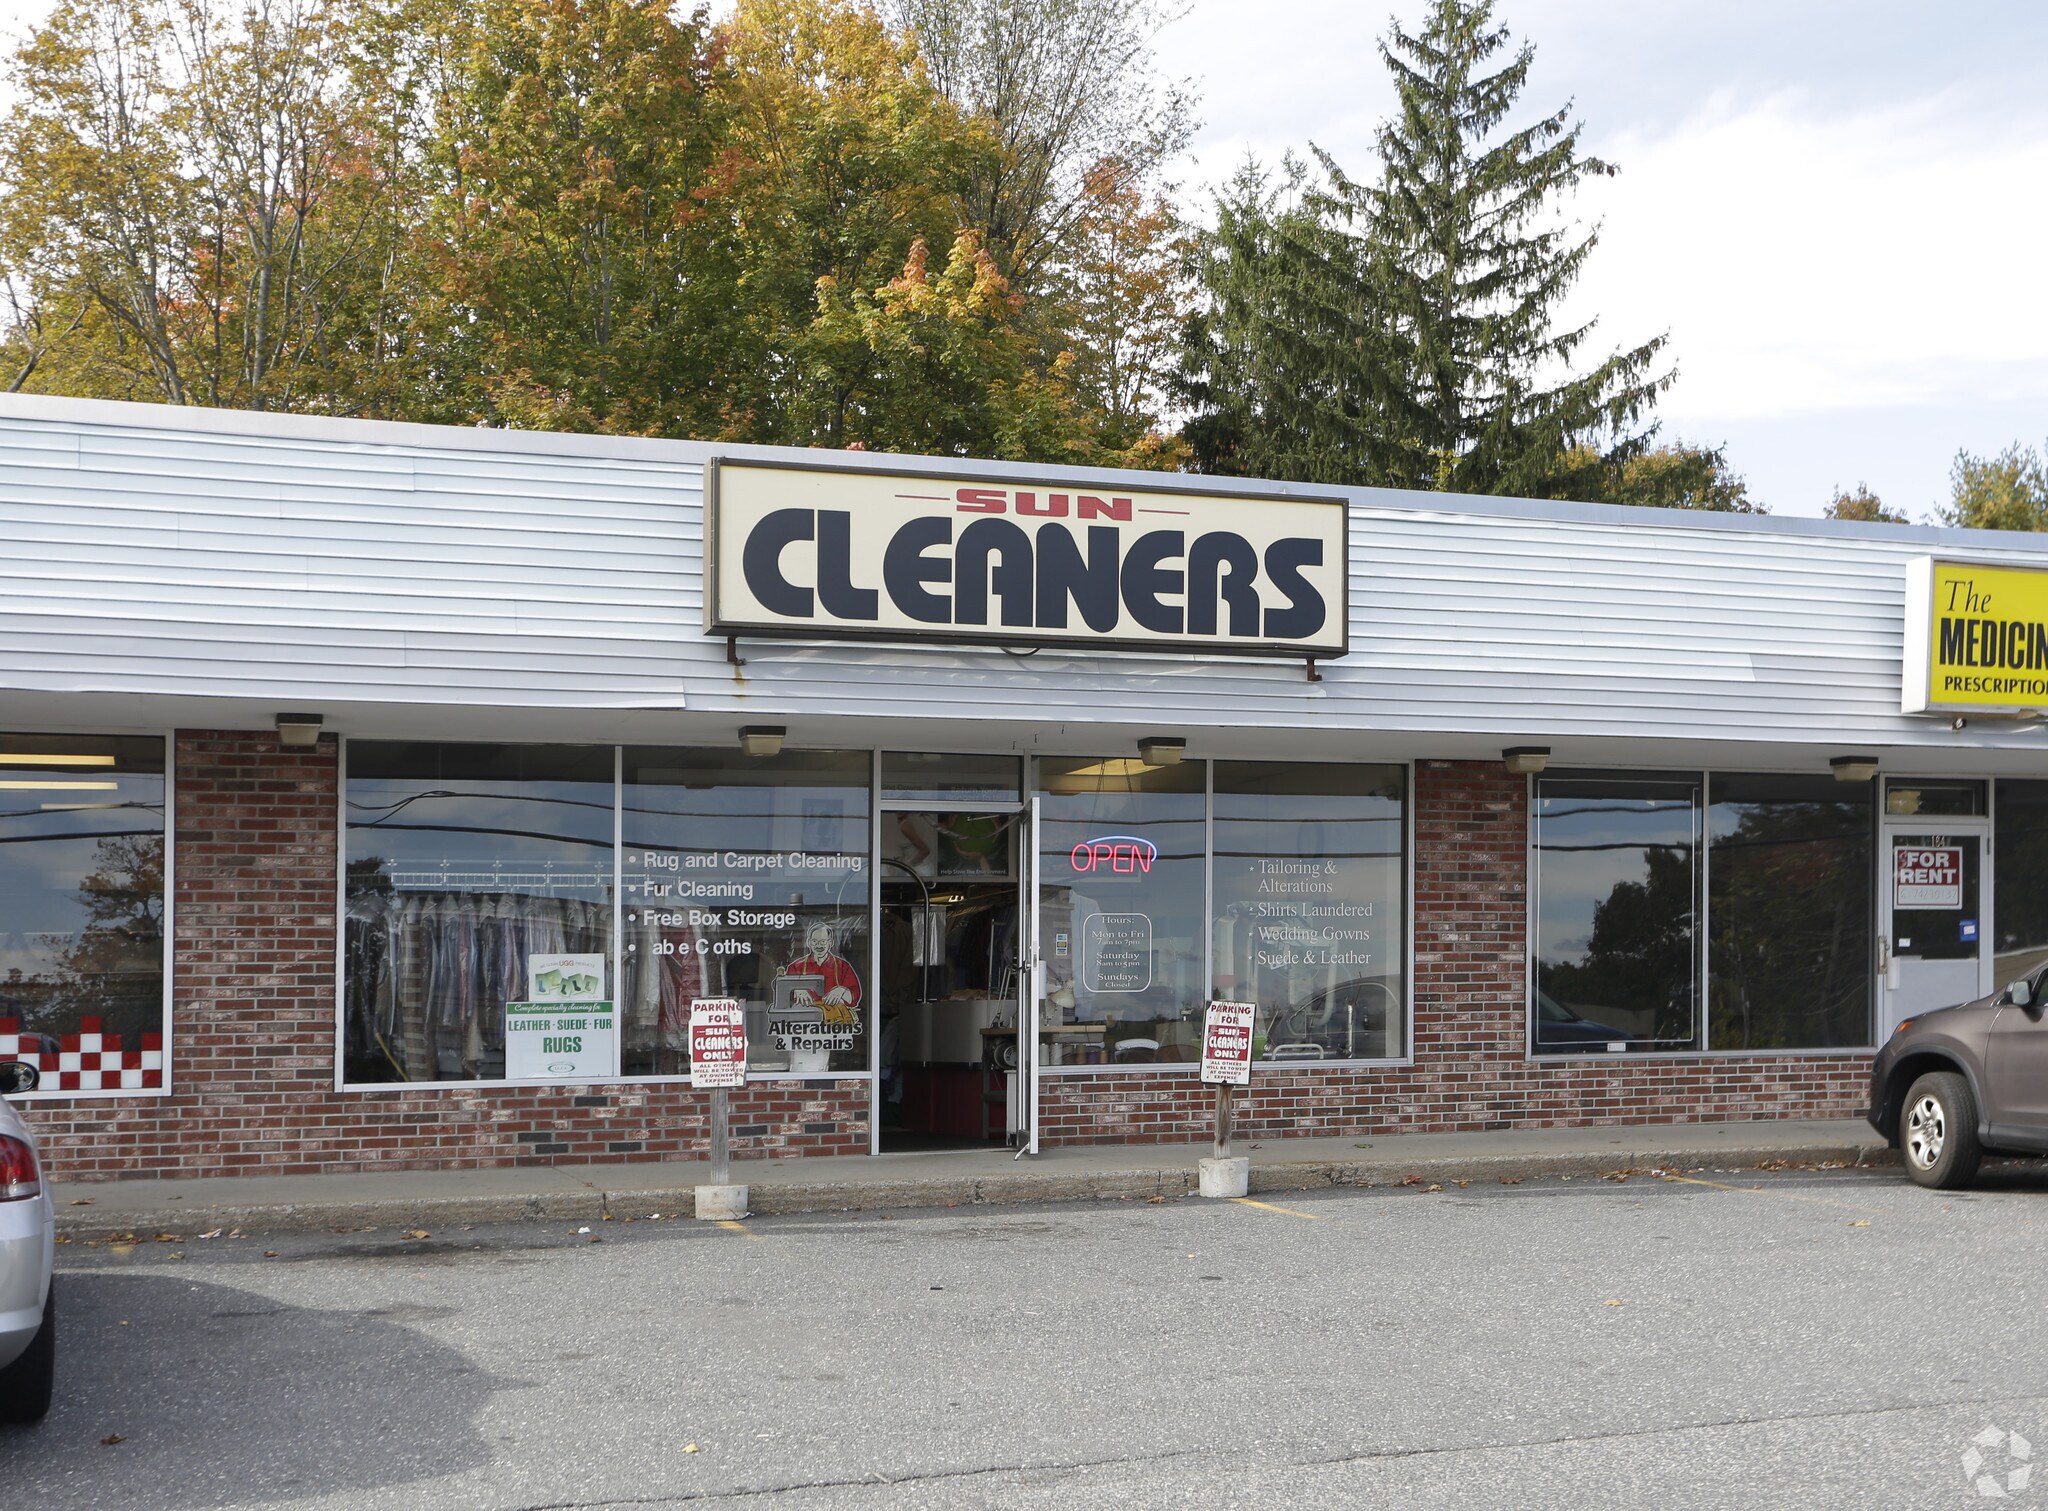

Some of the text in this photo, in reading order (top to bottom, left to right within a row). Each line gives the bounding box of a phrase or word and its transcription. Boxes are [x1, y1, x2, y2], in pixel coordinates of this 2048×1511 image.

[956, 488, 1133, 521] SUN
[743, 508, 1326, 639] CLEANERS
[1944, 580, 1992, 613] The
[1944, 676, 2048, 695] PRESCRIPTIO
[644, 852, 862, 871] Rug and Carpet Cleaning
[1071, 844, 1152, 873] OPEN
[1906, 852, 1950, 867] FOR
[1258, 860, 1337, 878] Tailoring &
[1900, 868, 1956, 884] RENT
[644, 881, 753, 900] Fur Cleaning
[1258, 878, 1333, 893] Alterations
[1258, 902, 1373, 917] Shirts Laundered
[644, 909, 795, 928] Free Box Storage
[1102, 916, 1134, 924] Hours:
[1091, 930, 1115, 938] Mon
[1130, 930, 1144, 938] Fri
[1258, 926, 1370, 944] Wedding Gowns
[1096, 952, 1140, 960] Saturday
[1258, 950, 1371, 964] Suede & Leather
[1097, 973, 1138, 981] Sundays
[514, 1003, 542, 1013] Complete
[568, 1002, 592, 1012] cleaning
[1211, 1004, 1251, 1014] PARKING
[508, 1019, 612, 1031] LEATHER SUEDE FUR
[708, 1015, 730, 1023] FOR
[1221, 1016, 1239, 1024] FOR
[768, 1020, 862, 1035] Alterations
[1218, 1028, 1240, 1036] SUN
[543, 1036, 582, 1053] RUGS
[694, 1036, 743, 1050] CLEANERS
[775, 1035, 854, 1054] & Repairs
[1208, 1036, 1247, 1050] CLEANERS
[702, 1051, 735, 1060] ONLY
[1214, 1050, 1240, 1059] ONLY
